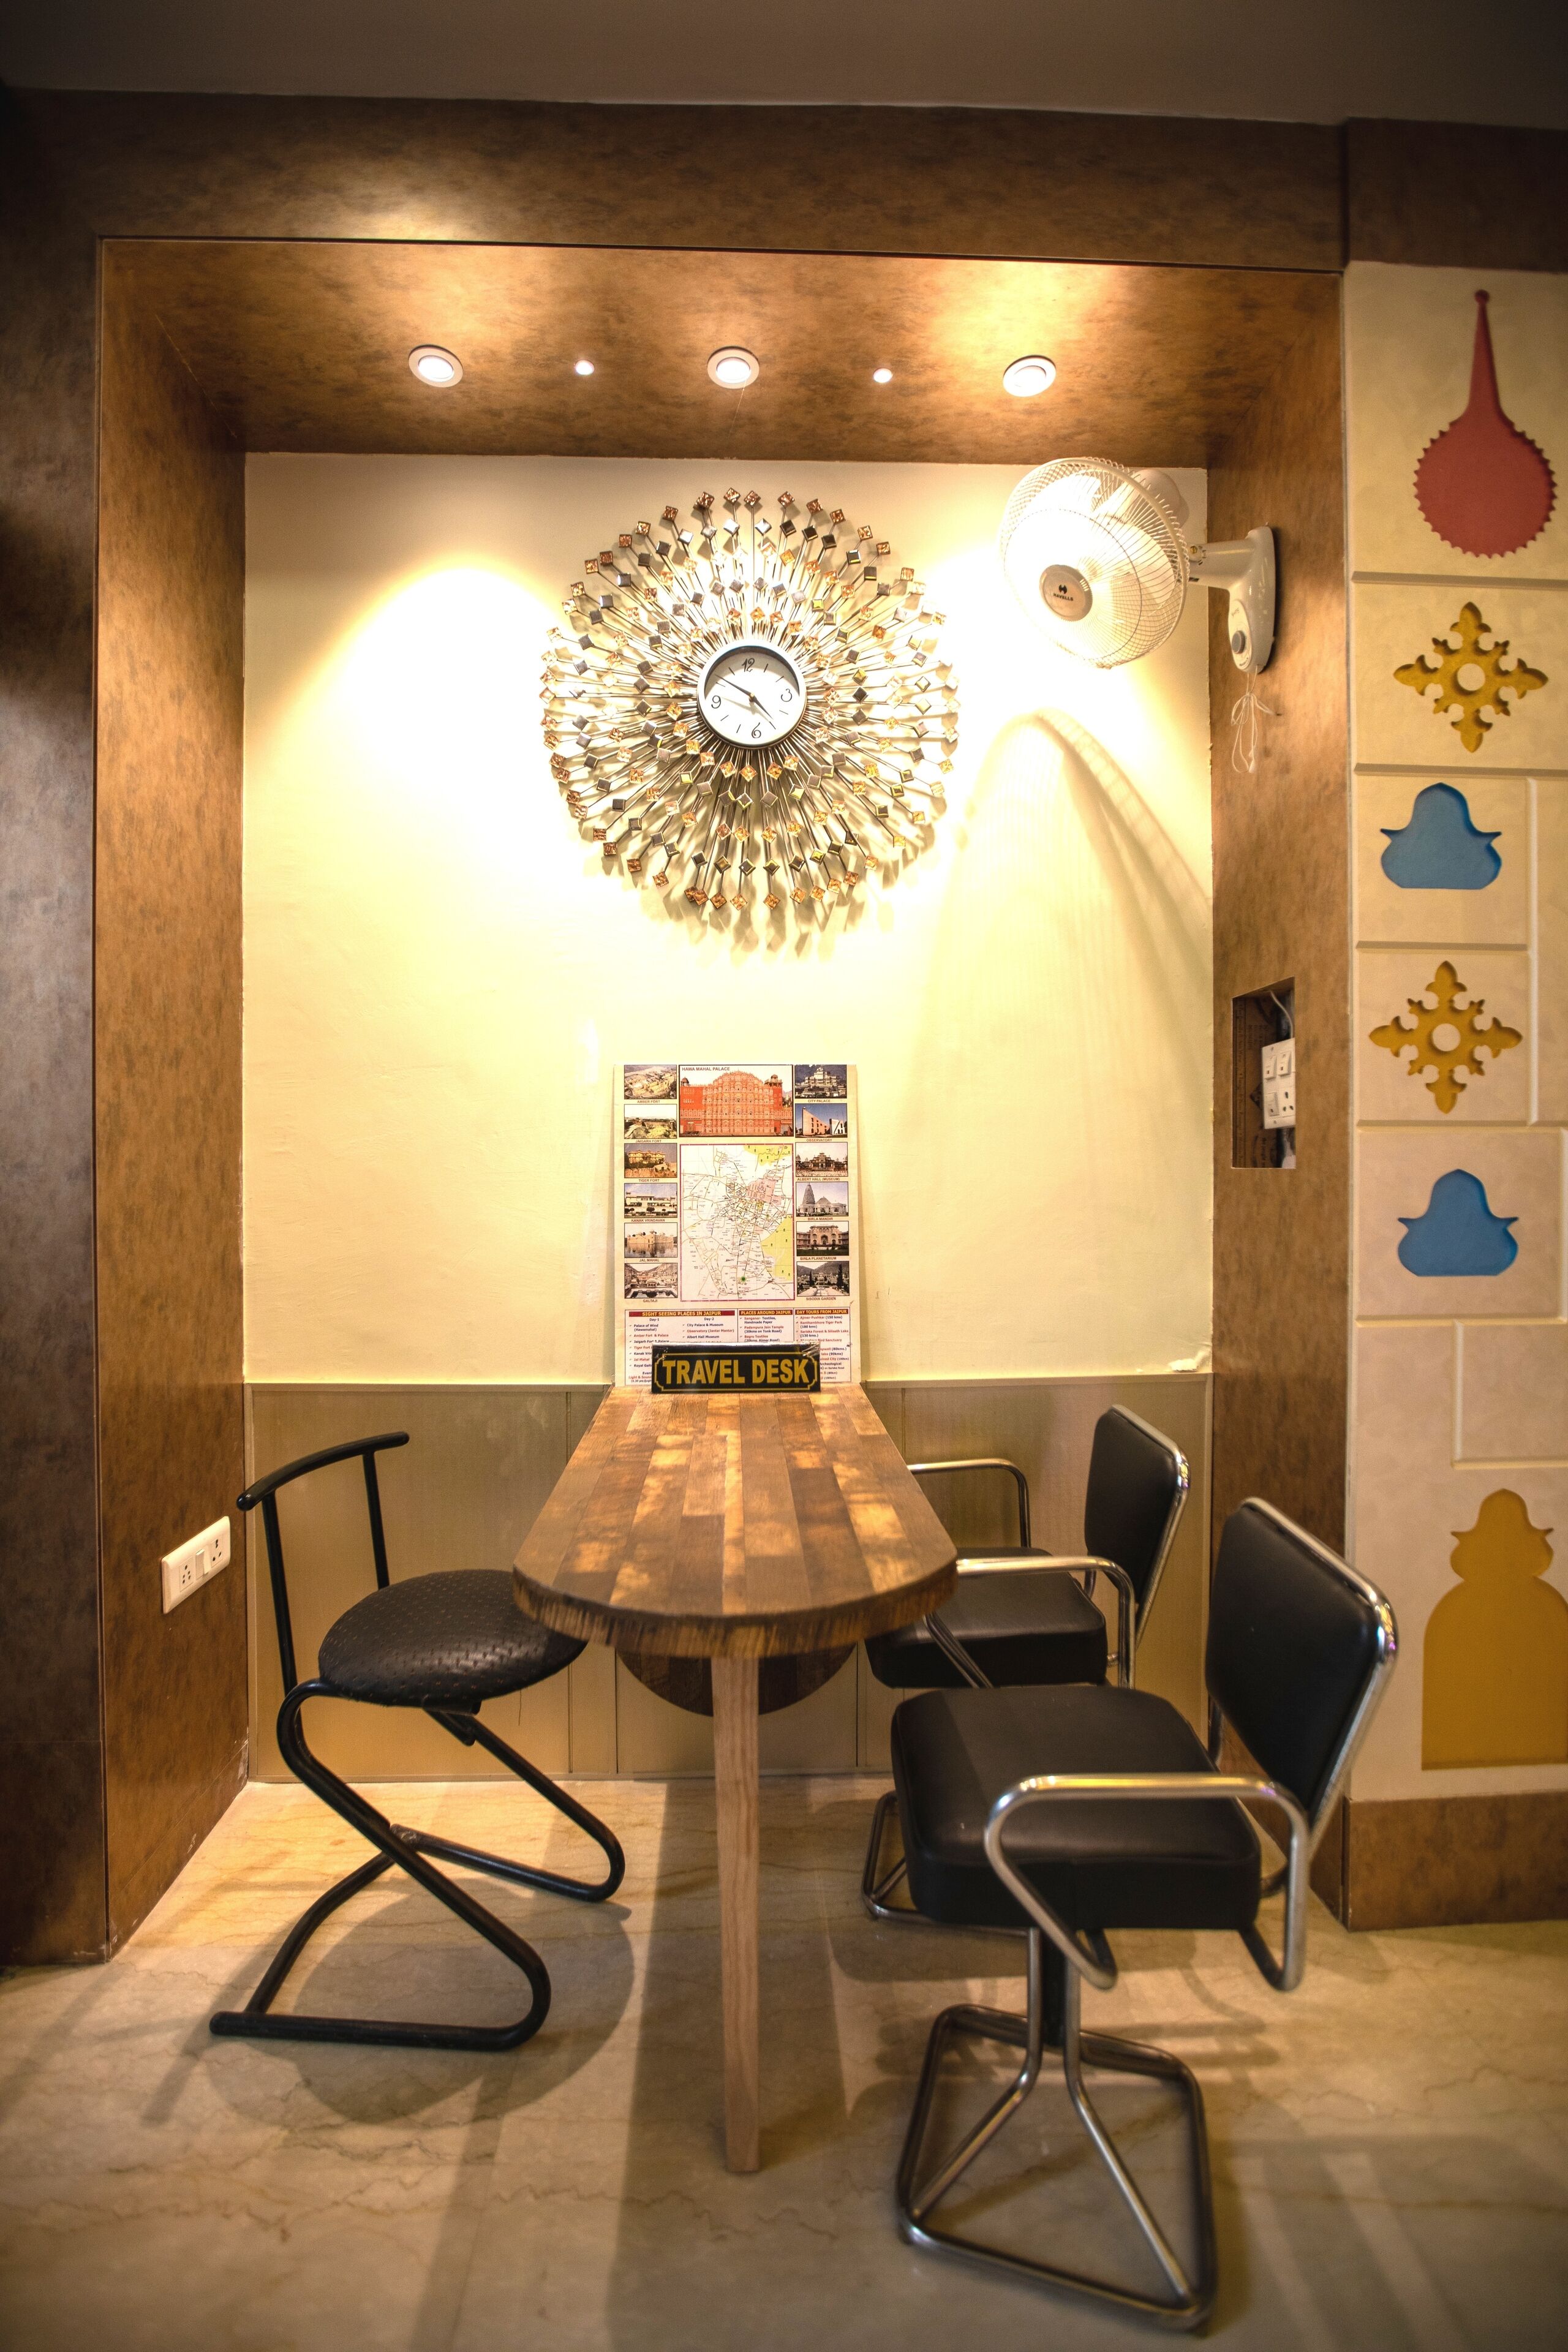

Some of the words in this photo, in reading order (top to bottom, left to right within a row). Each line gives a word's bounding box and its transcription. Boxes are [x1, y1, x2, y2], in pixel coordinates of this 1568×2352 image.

[742, 658, 755, 672] 12
[711, 695, 722, 709] 9
[781, 688, 793, 702] 3
[752, 722, 761, 738] 6
[662, 1359, 745, 1384] TRAVEL
[752, 1359, 809, 1384] DESK
